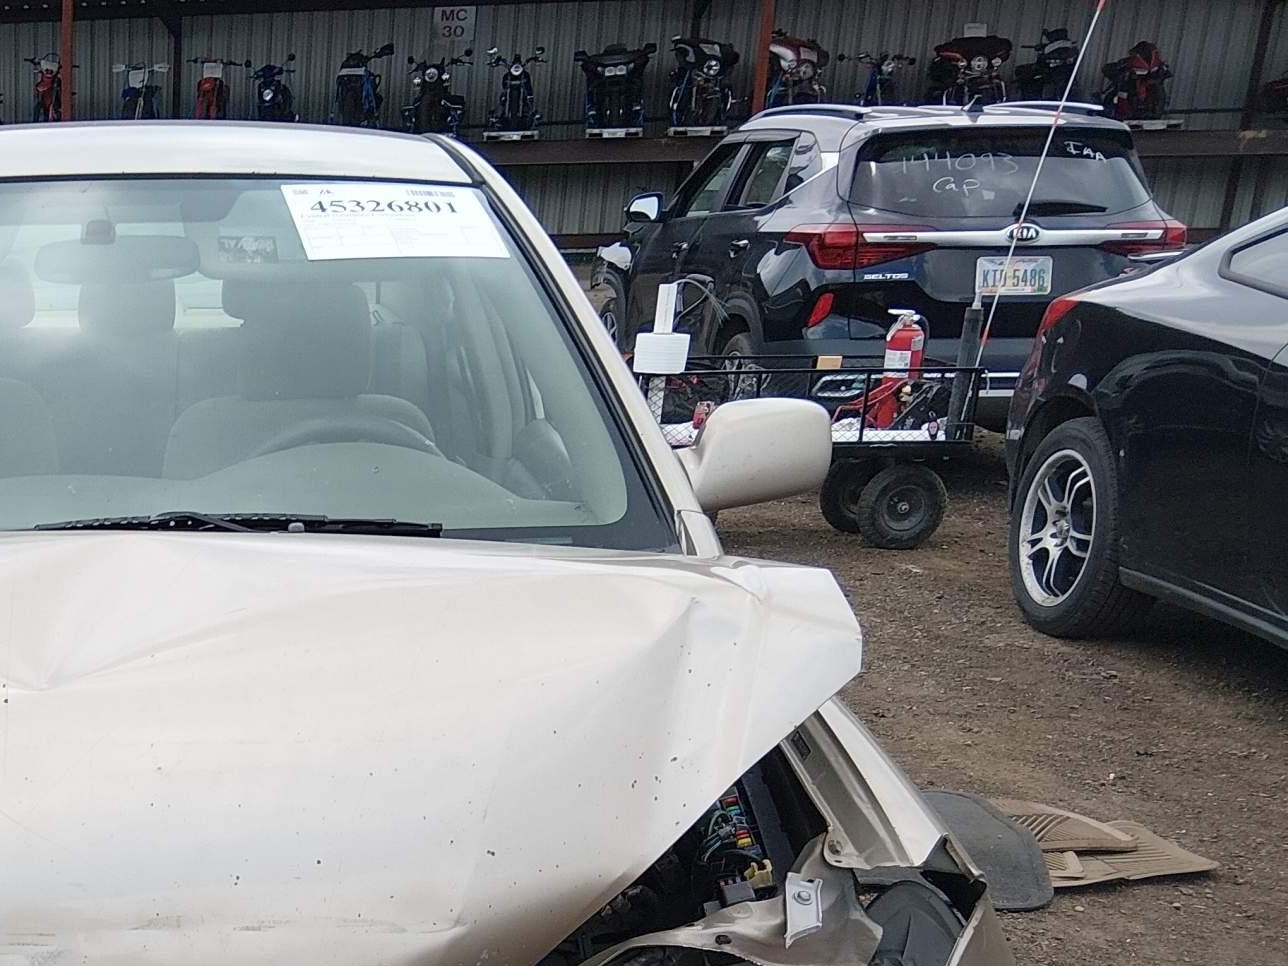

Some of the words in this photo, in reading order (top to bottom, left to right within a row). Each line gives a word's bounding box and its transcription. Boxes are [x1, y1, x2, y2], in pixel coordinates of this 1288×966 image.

[440, 8, 468, 21] MC
[442, 25, 465, 38] 30
[309, 199, 458, 214] 45326801
[1012, 228, 1036, 239] KIA
[1012, 269, 1046, 288] 5486
